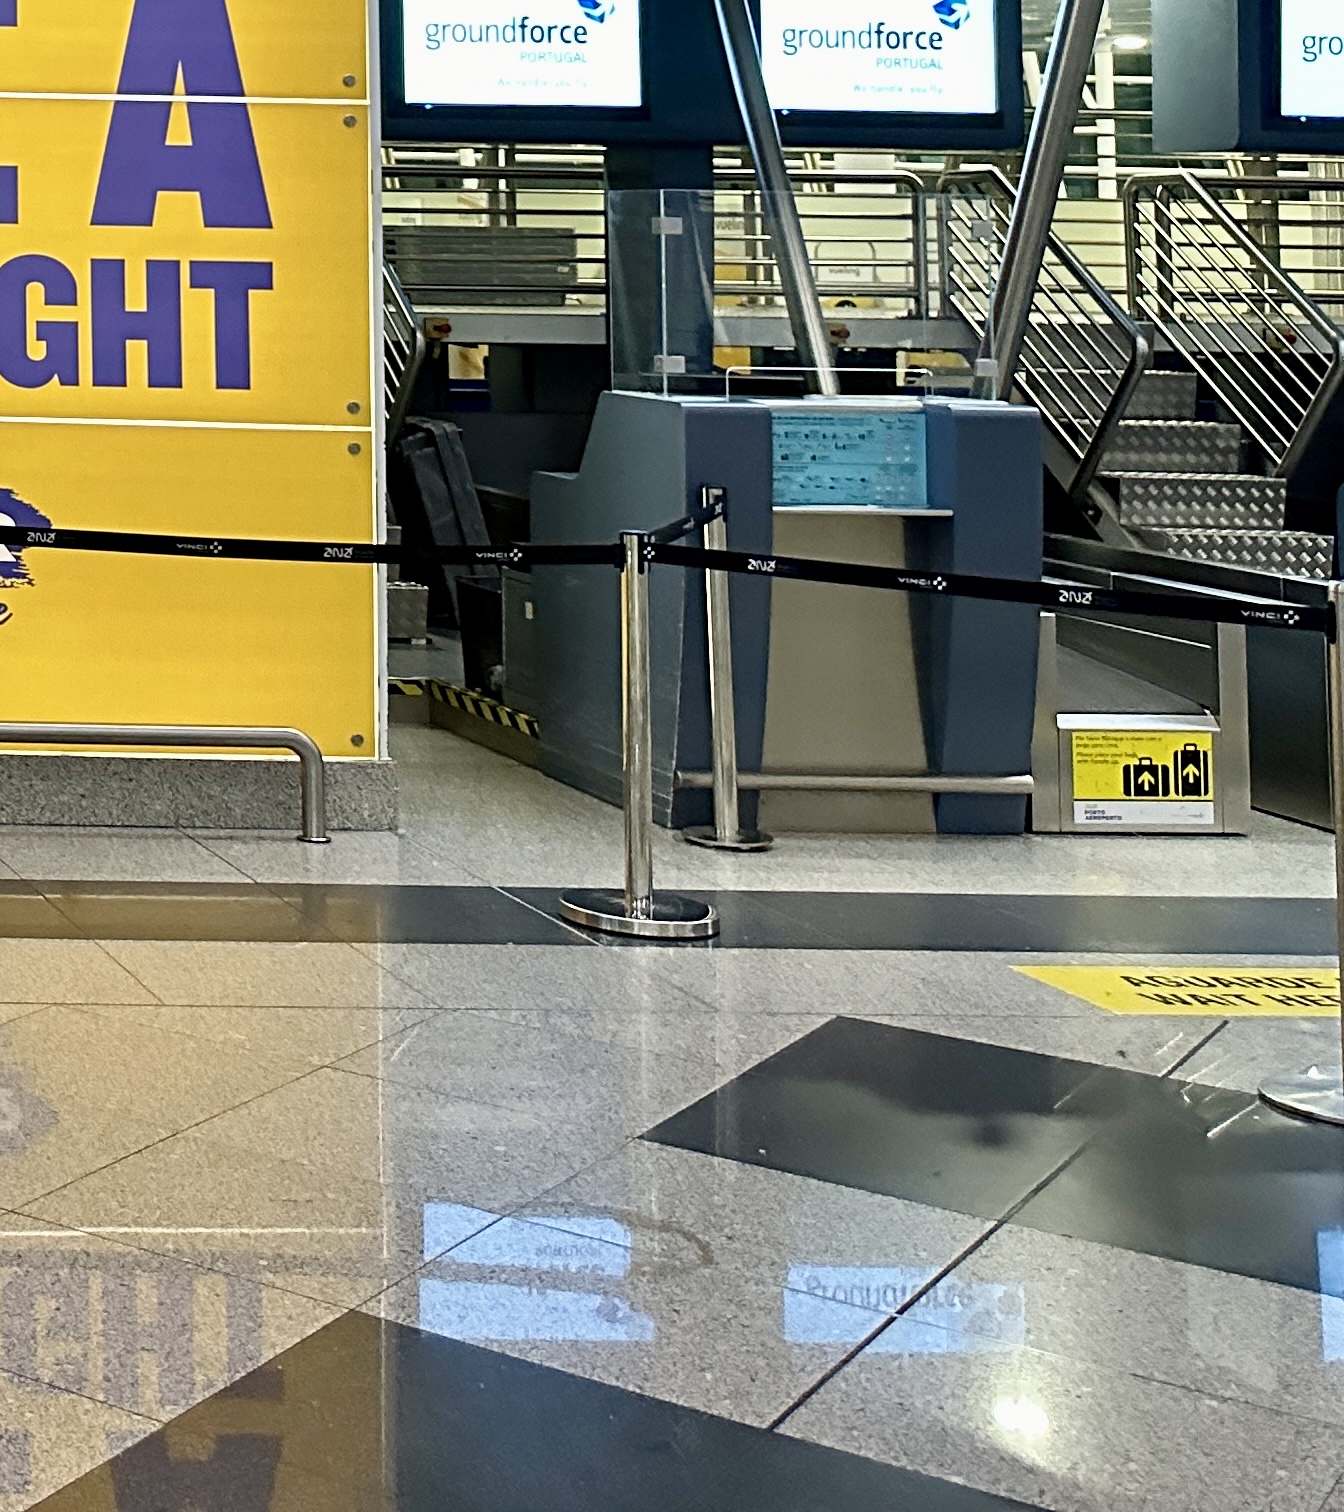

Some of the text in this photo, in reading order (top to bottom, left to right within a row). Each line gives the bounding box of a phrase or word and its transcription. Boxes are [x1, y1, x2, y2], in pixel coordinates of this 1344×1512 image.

[424, 16, 588, 50] groundforce
[782, 22, 943, 56] groundforce
[519, 51, 588, 63] PORTUGAL
[876, 57, 943, 70] PORTUGAL
[475, 551, 508, 559] VINCI
[897, 576, 931, 586] VINCI
[1240, 609, 1281, 620] VINCI
[1120, 975, 1336, 989] AGUARDE
[1135, 992, 1262, 1006] WAIT
